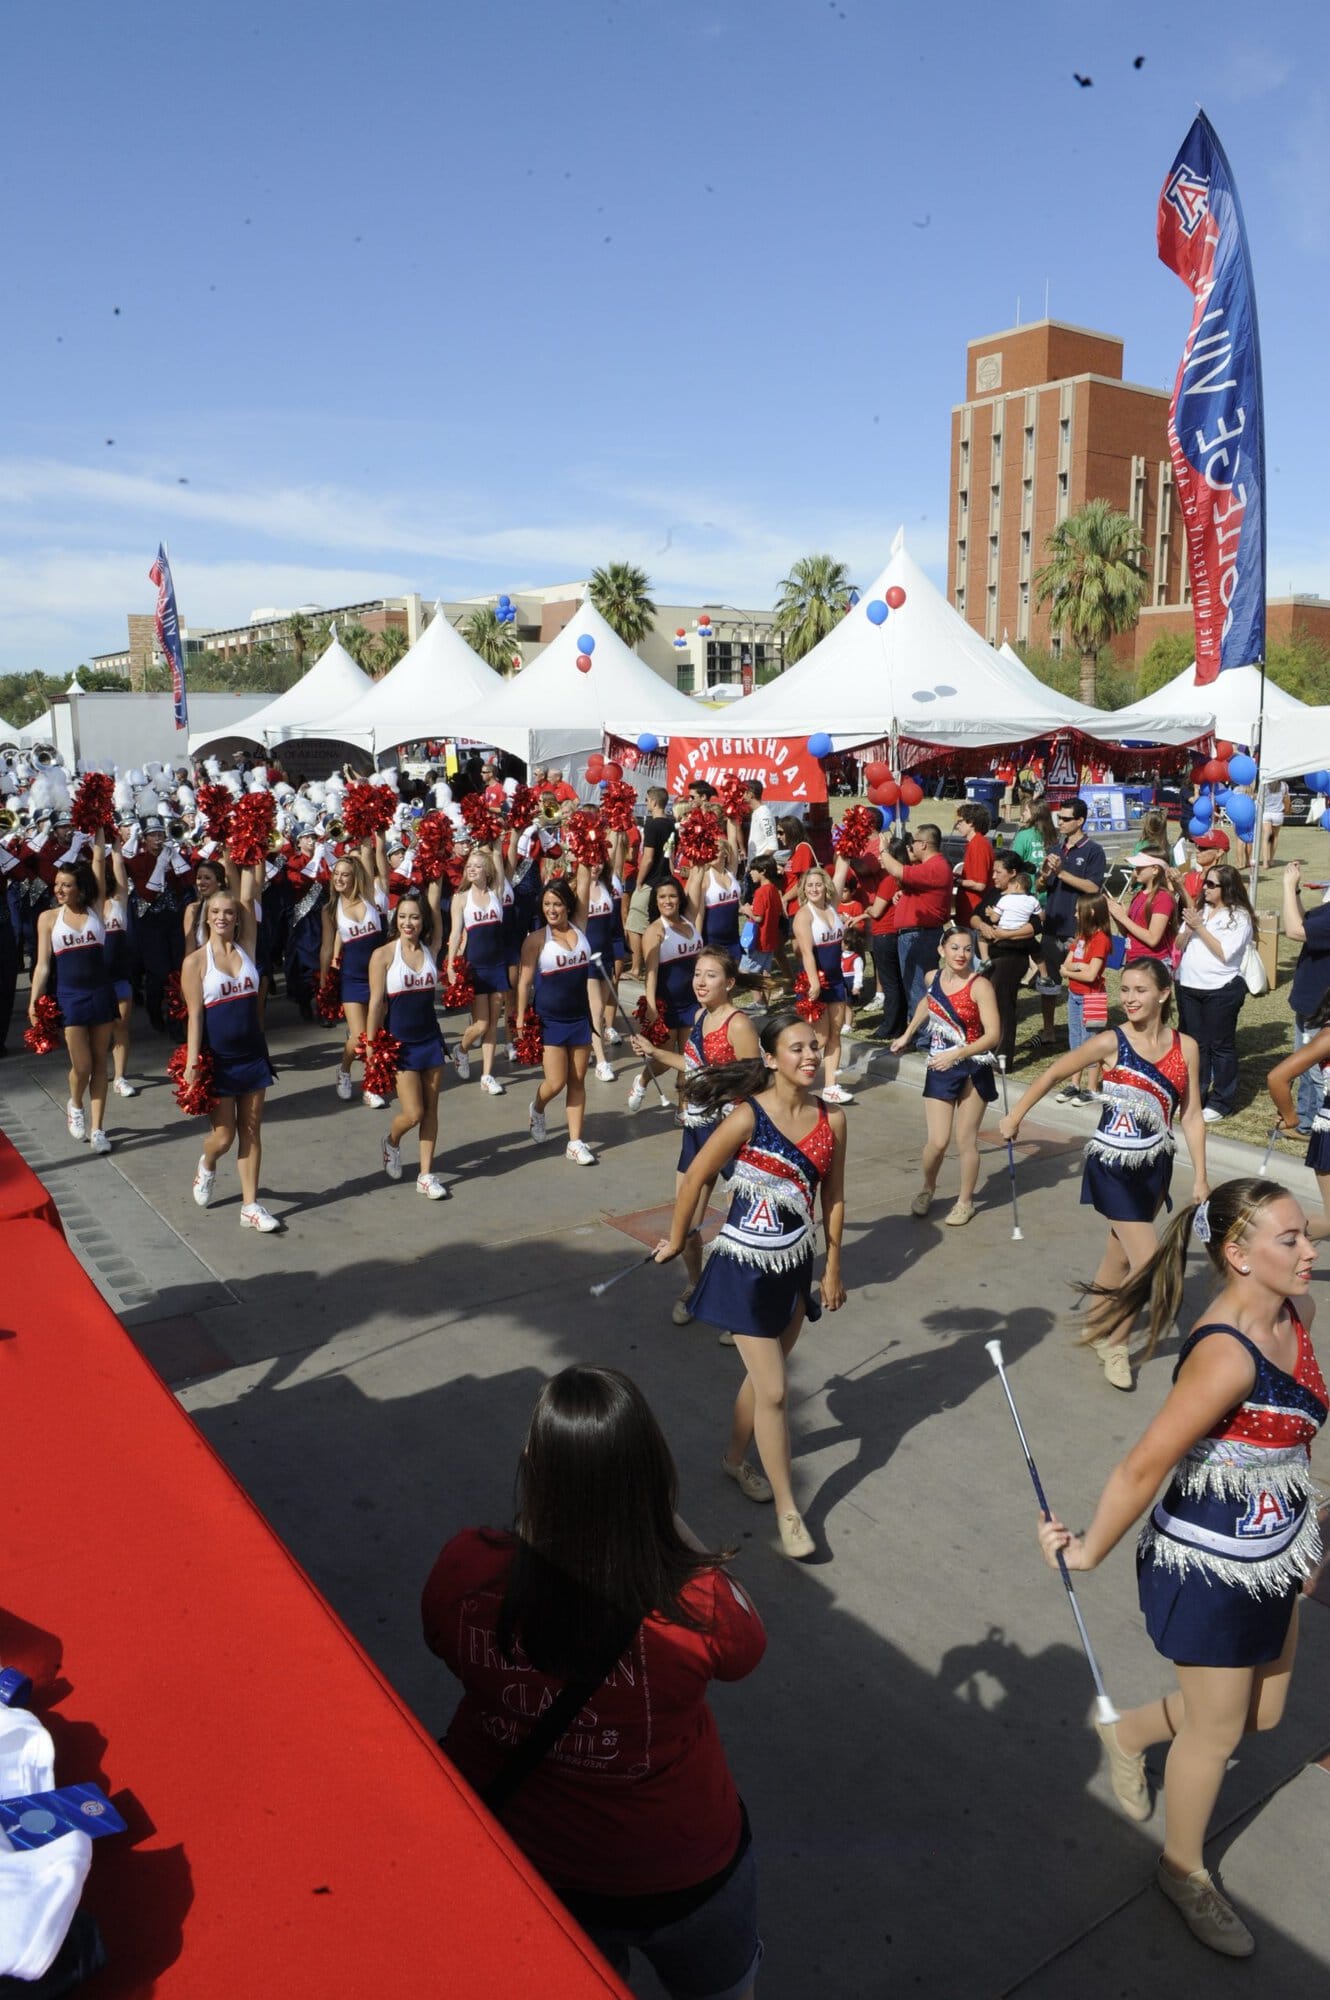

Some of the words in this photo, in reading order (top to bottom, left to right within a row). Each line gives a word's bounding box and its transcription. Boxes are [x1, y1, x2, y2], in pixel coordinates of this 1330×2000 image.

[672, 737, 719, 796] HAPPY
[721, 737, 808, 798] BIRTHDAY
[1104, 1105, 1142, 1139] A
[739, 1193, 784, 1236] A
[1235, 1480, 1295, 1538] A
[502, 1683, 598, 1728] CLAS
